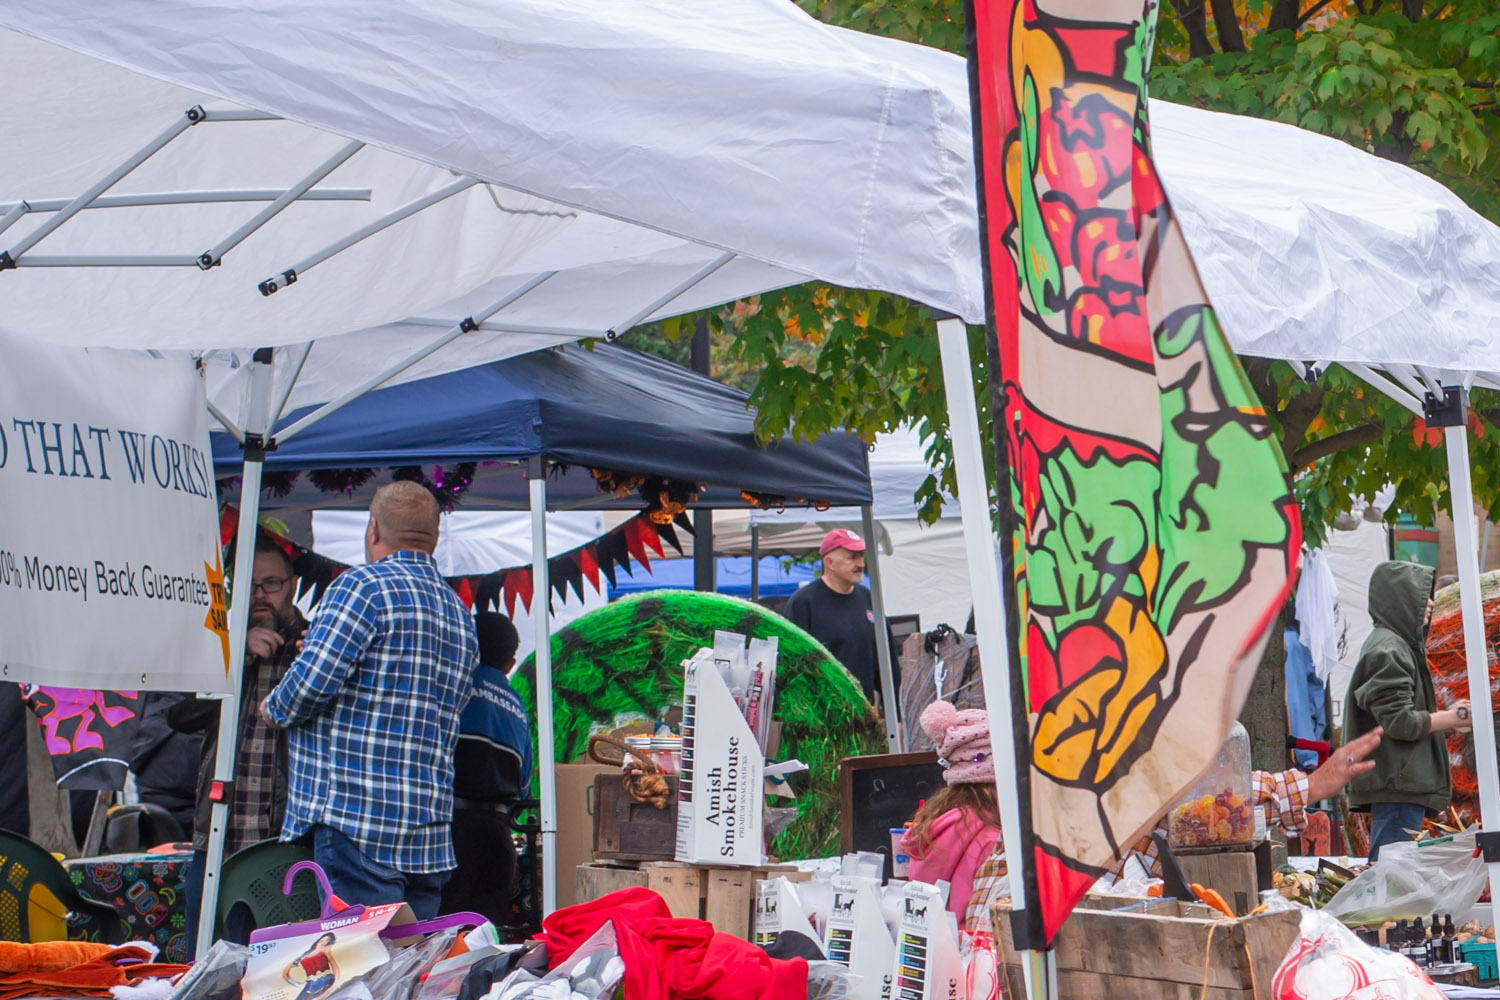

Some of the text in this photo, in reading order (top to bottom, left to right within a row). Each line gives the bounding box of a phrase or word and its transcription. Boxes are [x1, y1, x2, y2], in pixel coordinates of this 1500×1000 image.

[12, 417, 111, 481] THAT
[117, 430, 213, 500] WORKS!
[24, 556, 88, 602] Money
[94, 560, 139, 598] Back
[141, 563, 210, 607] Guarantee
[470, 687, 528, 724] AMBASSADO
[705, 767, 722, 827] Amish
[720, 736, 740, 858] Smokehouse
[738, 805, 746, 839] PREMIUM
[320, 916, 359, 931] WOMAN
